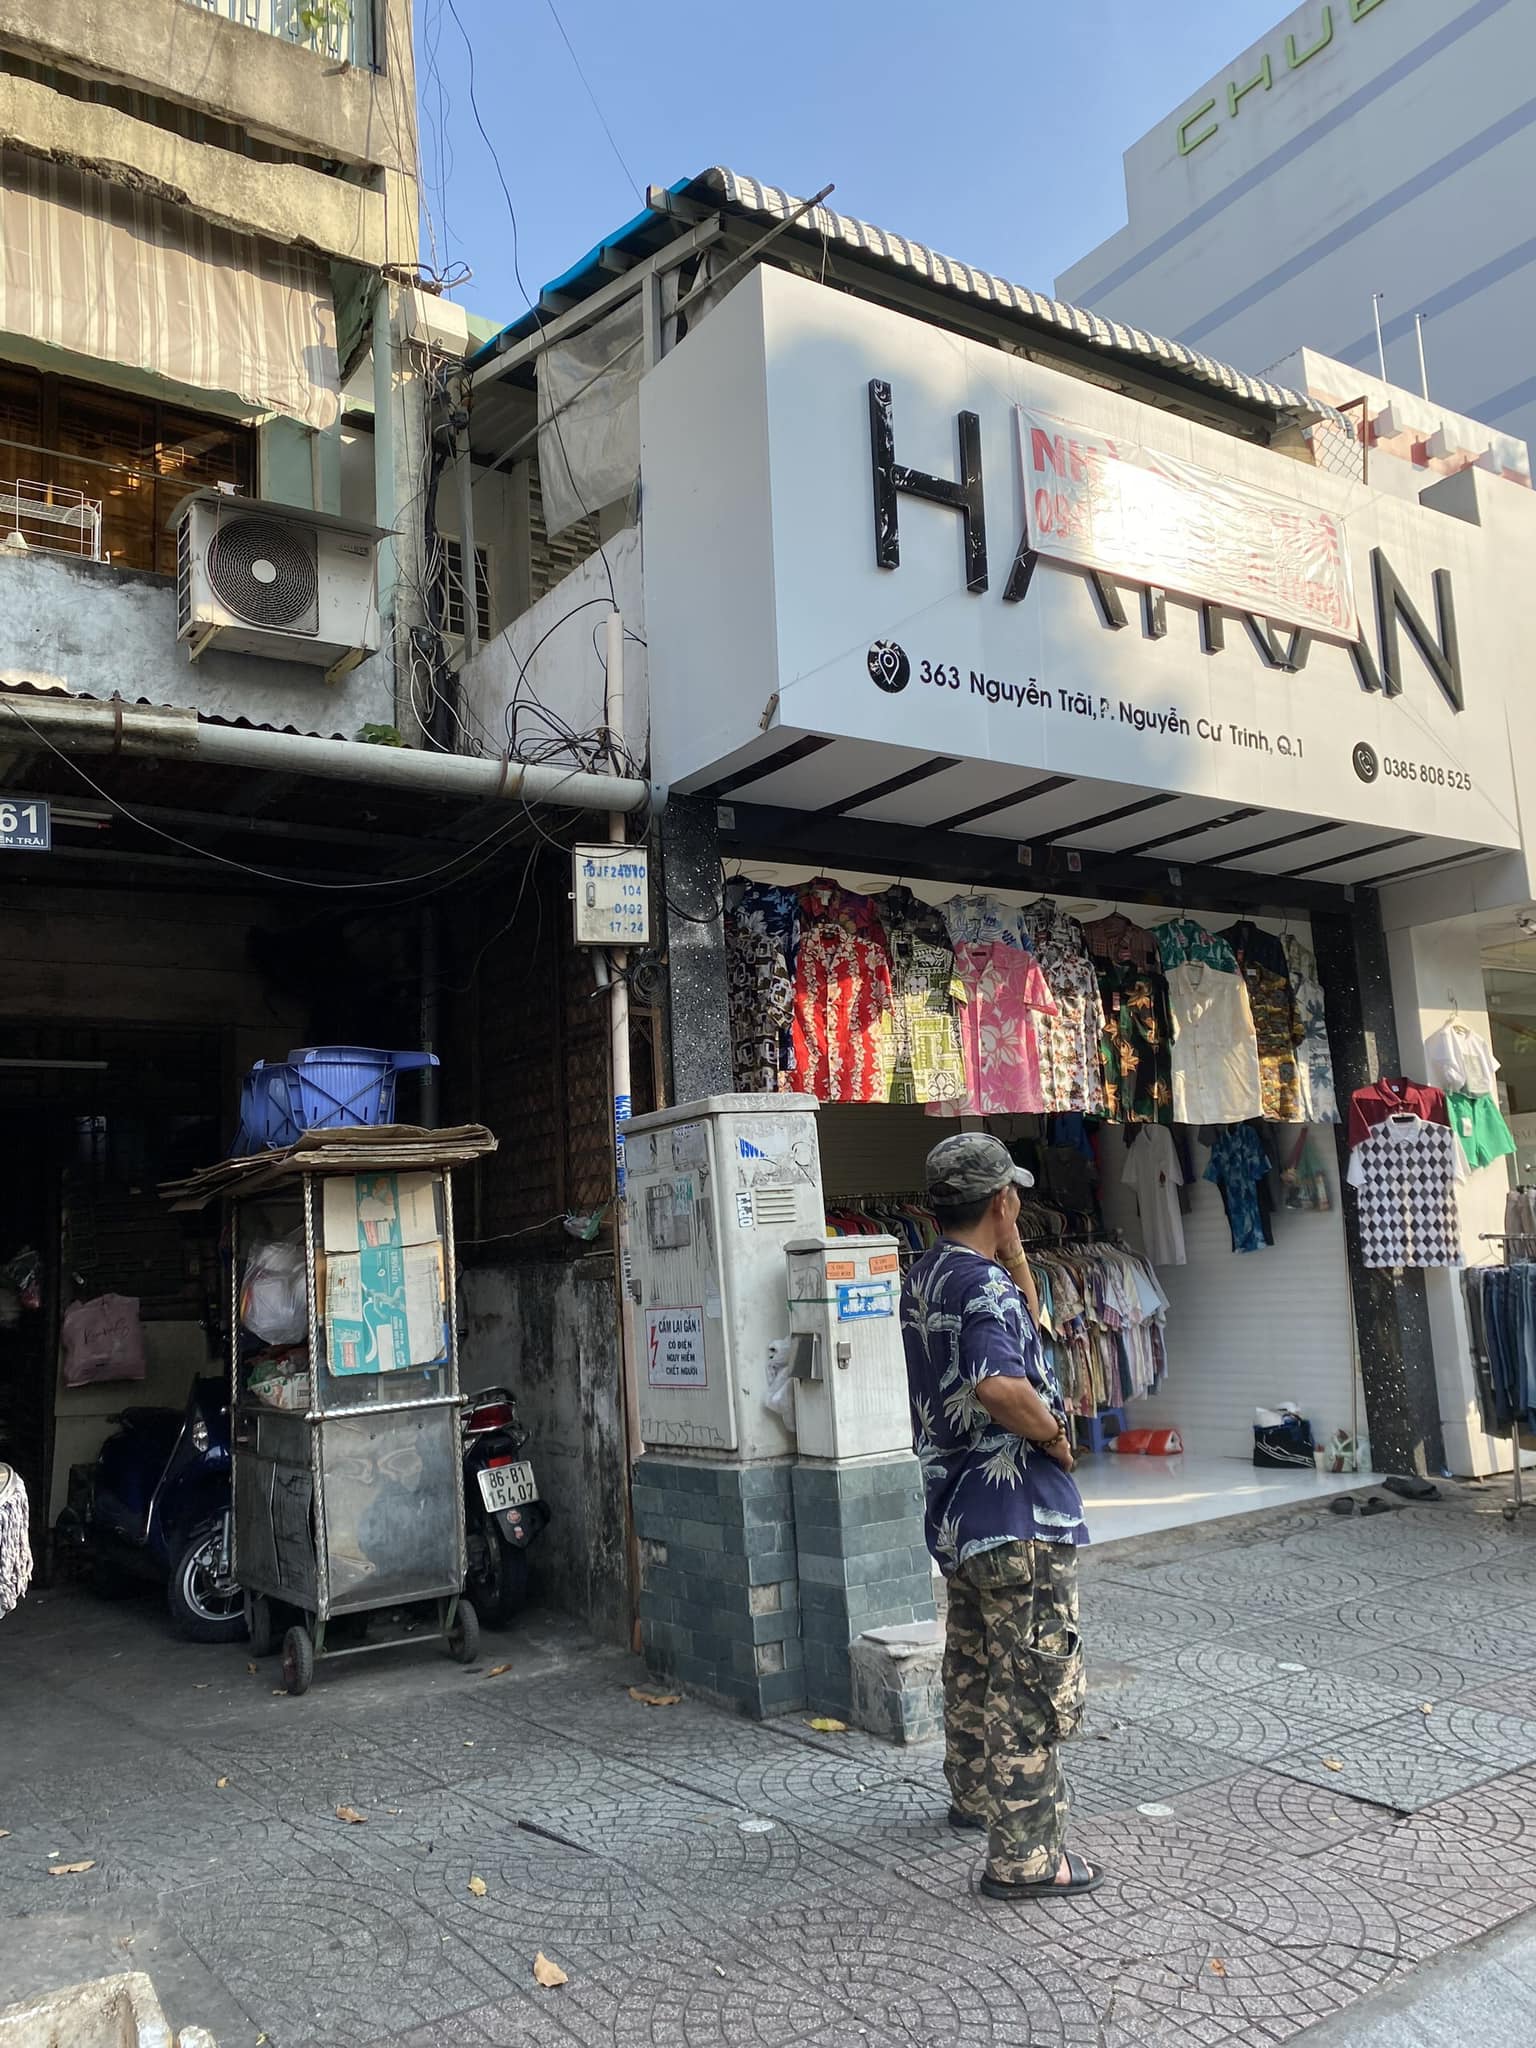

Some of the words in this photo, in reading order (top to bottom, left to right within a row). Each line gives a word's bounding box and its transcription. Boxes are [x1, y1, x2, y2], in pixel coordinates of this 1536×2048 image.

[920, 660, 960, 690] 363
[970, 671, 1052, 709] Nguyễn
[1119, 701, 1190, 736] Nguyễn
[1197, 718, 1223, 742] Cư
[1229, 724, 1273, 755] Trinh,
[1383, 757, 1417, 780] 0385
[1420, 764, 1445, 786] 808
[1448, 769, 1472, 791] 525
[0, 803, 37, 833] 61
[622, 885, 642, 896] 104
[489, 1467, 525, 1488] 86-B1
